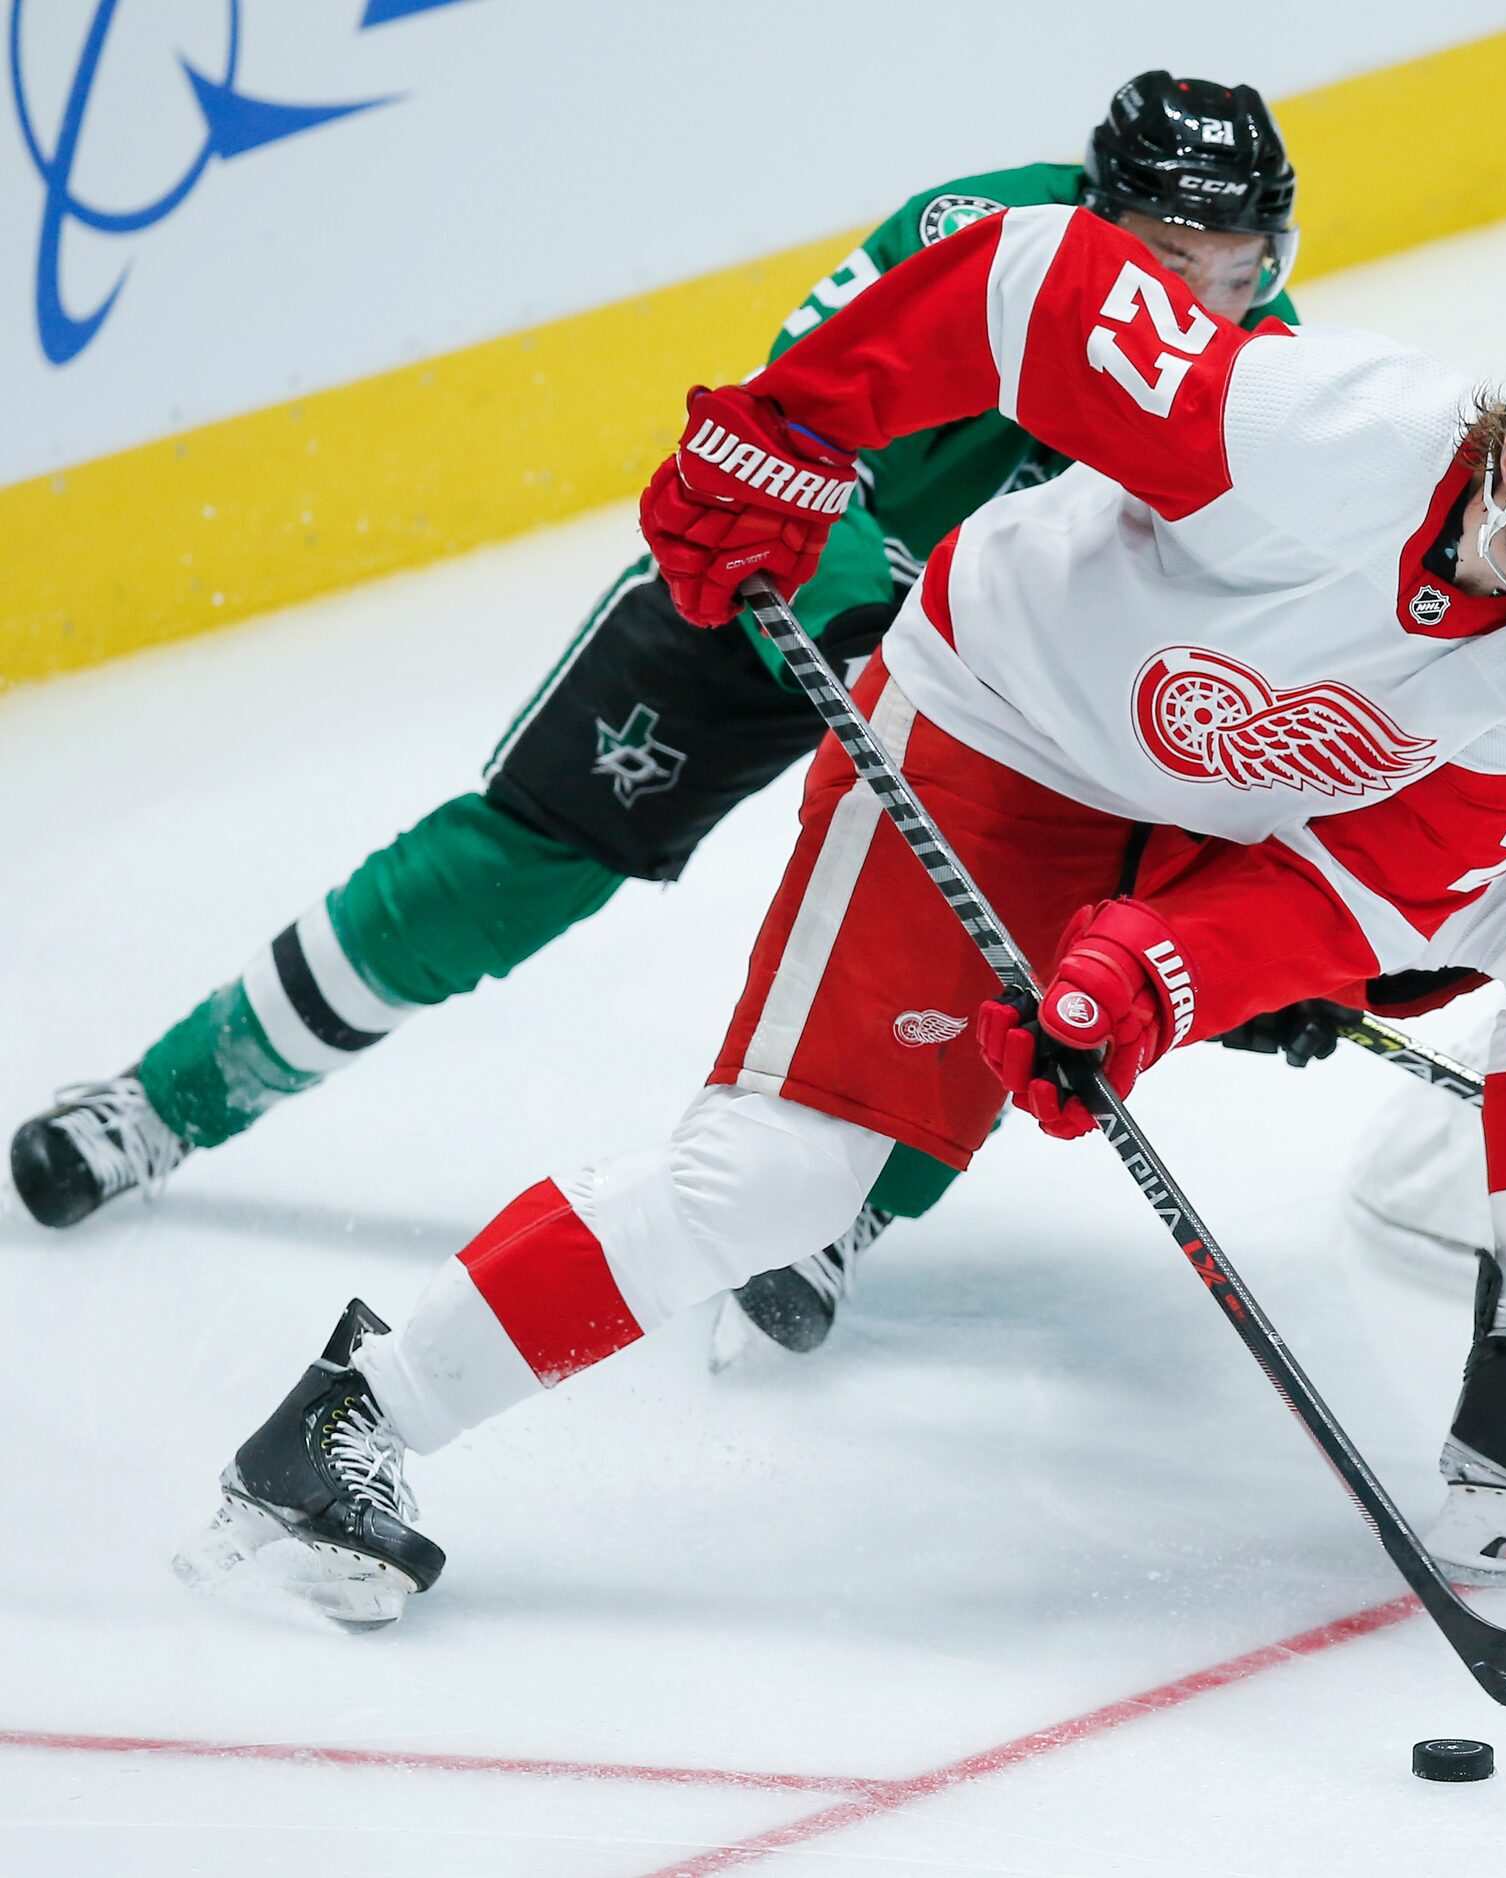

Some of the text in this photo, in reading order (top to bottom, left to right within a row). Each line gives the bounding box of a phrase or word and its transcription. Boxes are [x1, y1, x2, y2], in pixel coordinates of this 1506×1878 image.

[1201, 117, 1236, 146] 21
[1179, 175, 1249, 196] CCM
[1086, 260, 1219, 418] 27
[1415, 602, 1441, 612] NHL
